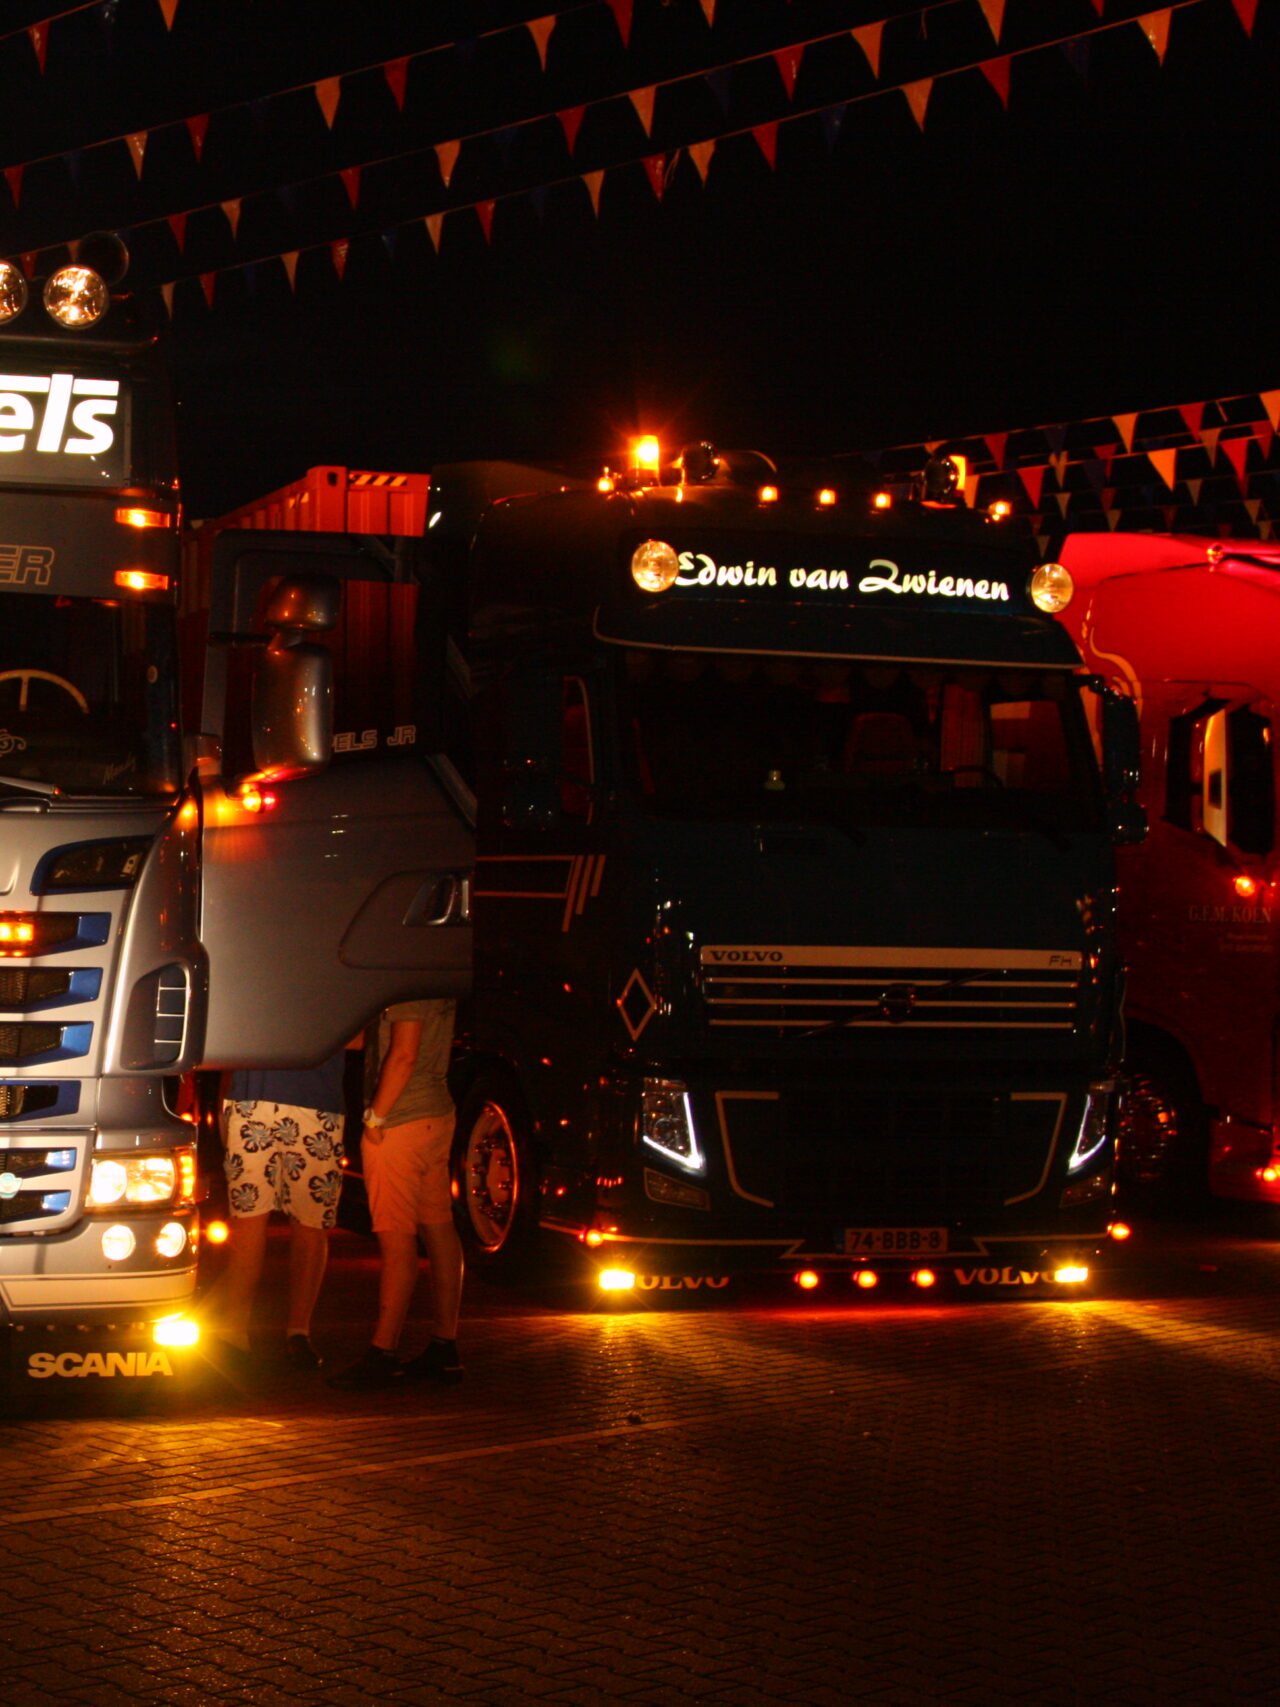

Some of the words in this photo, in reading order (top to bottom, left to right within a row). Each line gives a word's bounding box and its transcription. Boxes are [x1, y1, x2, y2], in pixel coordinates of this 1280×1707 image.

[675, 551, 777, 587] Edwin
[789, 567, 849, 590] van
[858, 558, 1010, 601] Zwienen
[332, 729, 378, 754] ELS
[386, 724, 418, 747] JR
[709, 949, 784, 963] VOLVO
[1048, 954, 1073, 968] FH
[632, 1272, 732, 1291] OLVO
[28, 1351, 174, 1379] SCANIA
